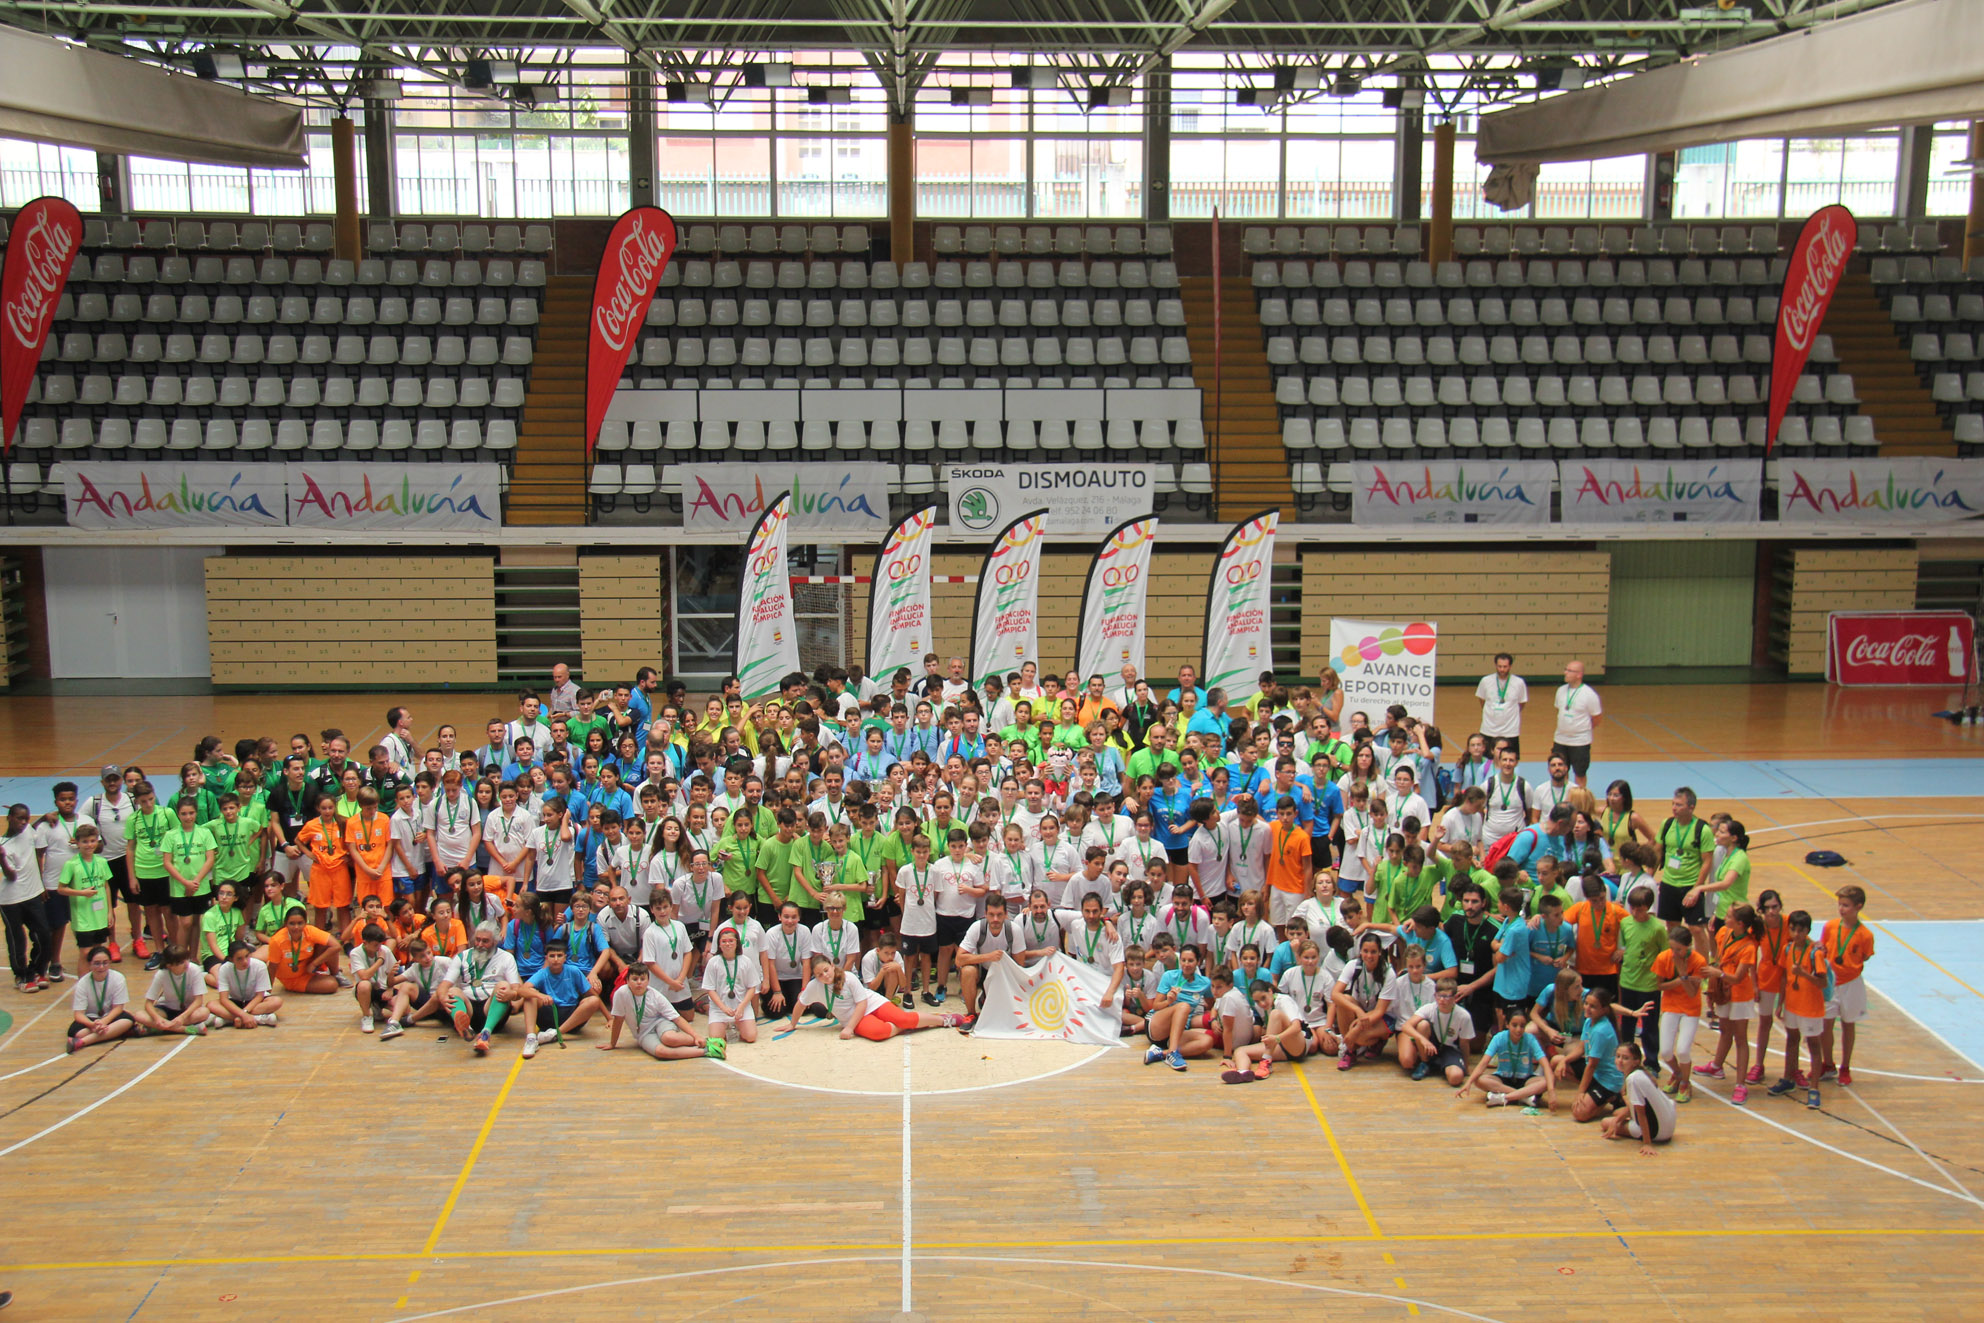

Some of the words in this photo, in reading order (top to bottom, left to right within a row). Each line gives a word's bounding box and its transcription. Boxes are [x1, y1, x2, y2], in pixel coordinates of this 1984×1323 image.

[597, 213, 665, 350] Coca-Cola
[952, 467, 1005, 478] ŠKODA
[1018, 470, 1146, 489] DISMOAUTO
[1366, 465, 1535, 506] Andalucía
[1576, 465, 1744, 506] Andalucía
[1783, 469, 1979, 514] Andalucía
[71, 471, 278, 519] Andalucía
[294, 471, 492, 521] Andalucía
[688, 472, 882, 521] Andlucía
[1363, 663, 1431, 678] AVANCE
[1846, 634, 1939, 666] Coca-Cola
[1338, 680, 1431, 697] EPORTIVO
[1360, 697, 1391, 705] derecho
[1401, 700, 1430, 708] deporte
